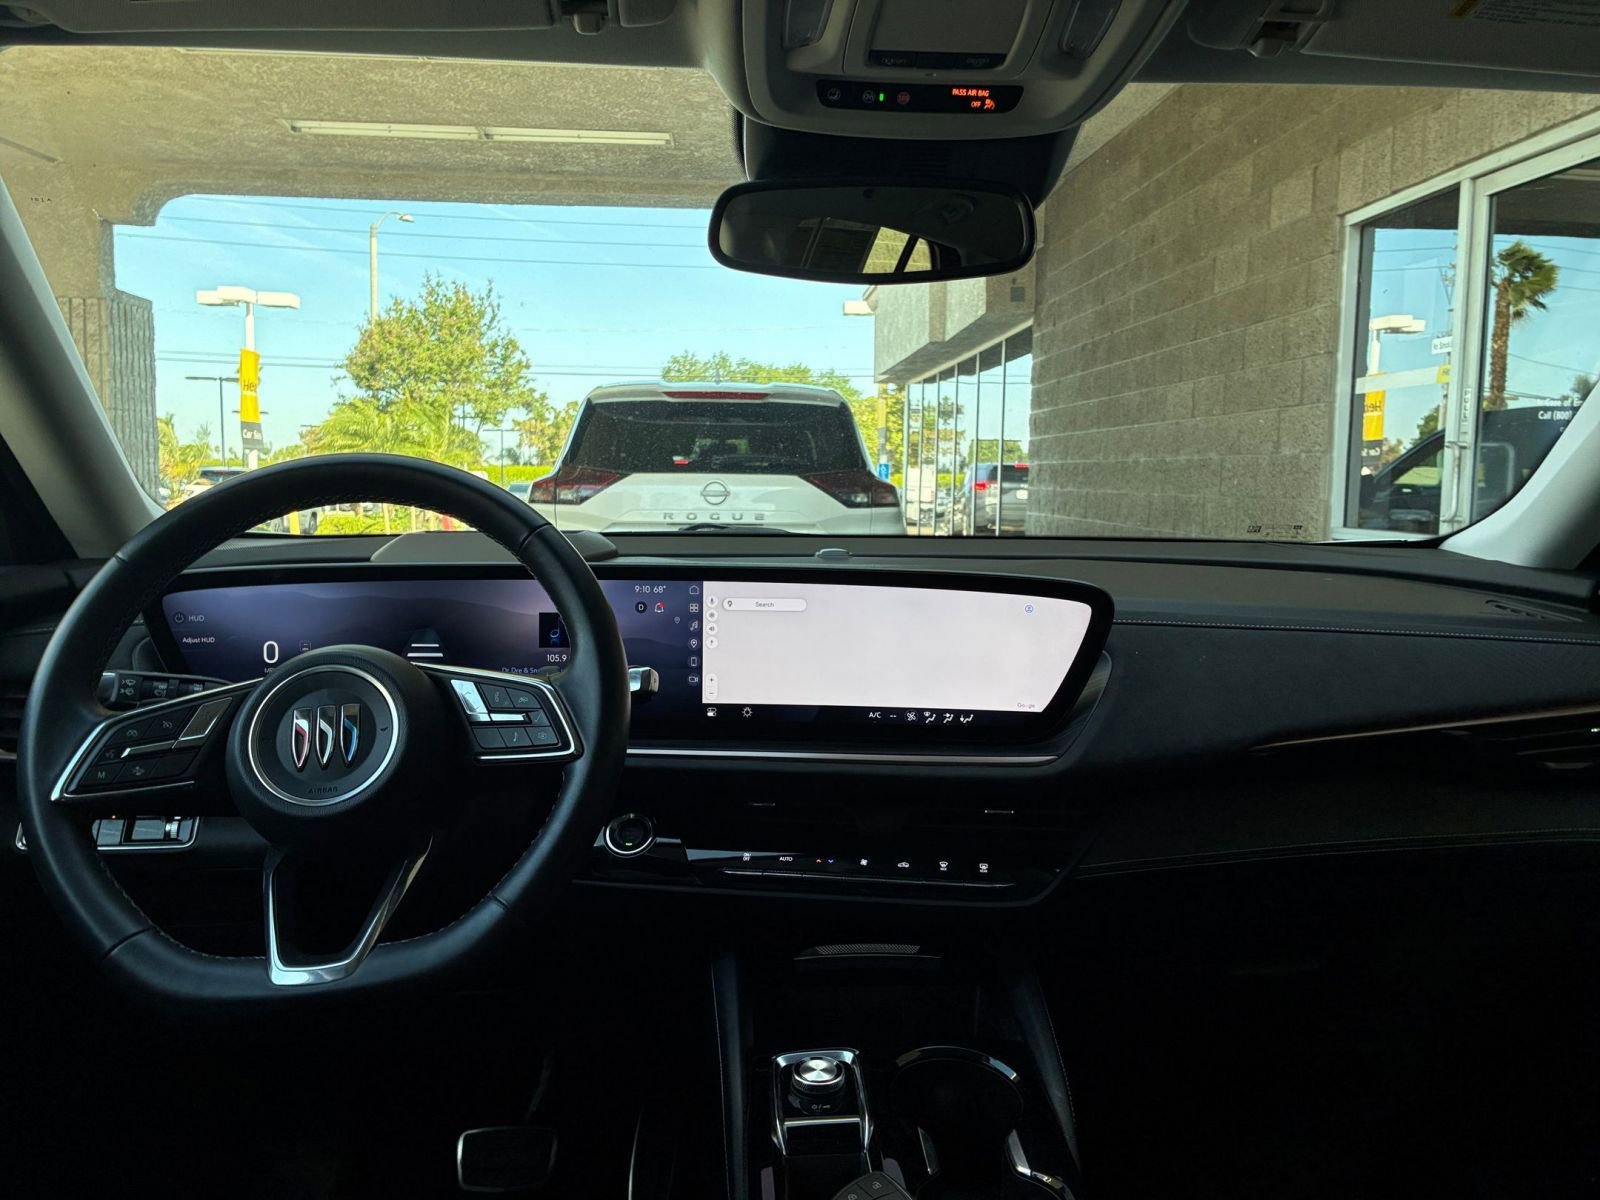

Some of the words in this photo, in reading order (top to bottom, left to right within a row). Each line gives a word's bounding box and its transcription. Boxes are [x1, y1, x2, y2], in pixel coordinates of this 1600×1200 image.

[952, 88, 967, 96] PASS
[978, 89, 990, 97] BAG
[1537, 410, 1552, 420] Call
[242, 429, 253, 438] Car
[663, 512, 765, 521] ROGUE
[634, 585, 650, 593] 9:10
[653, 585, 667, 593] 68°
[182, 636, 201, 644] Adjust
[263, 640, 279, 664] 0
[546, 654, 567, 662] 105.9
[868, 711, 882, 719] A/C
[97, 771, 106, 779] M
